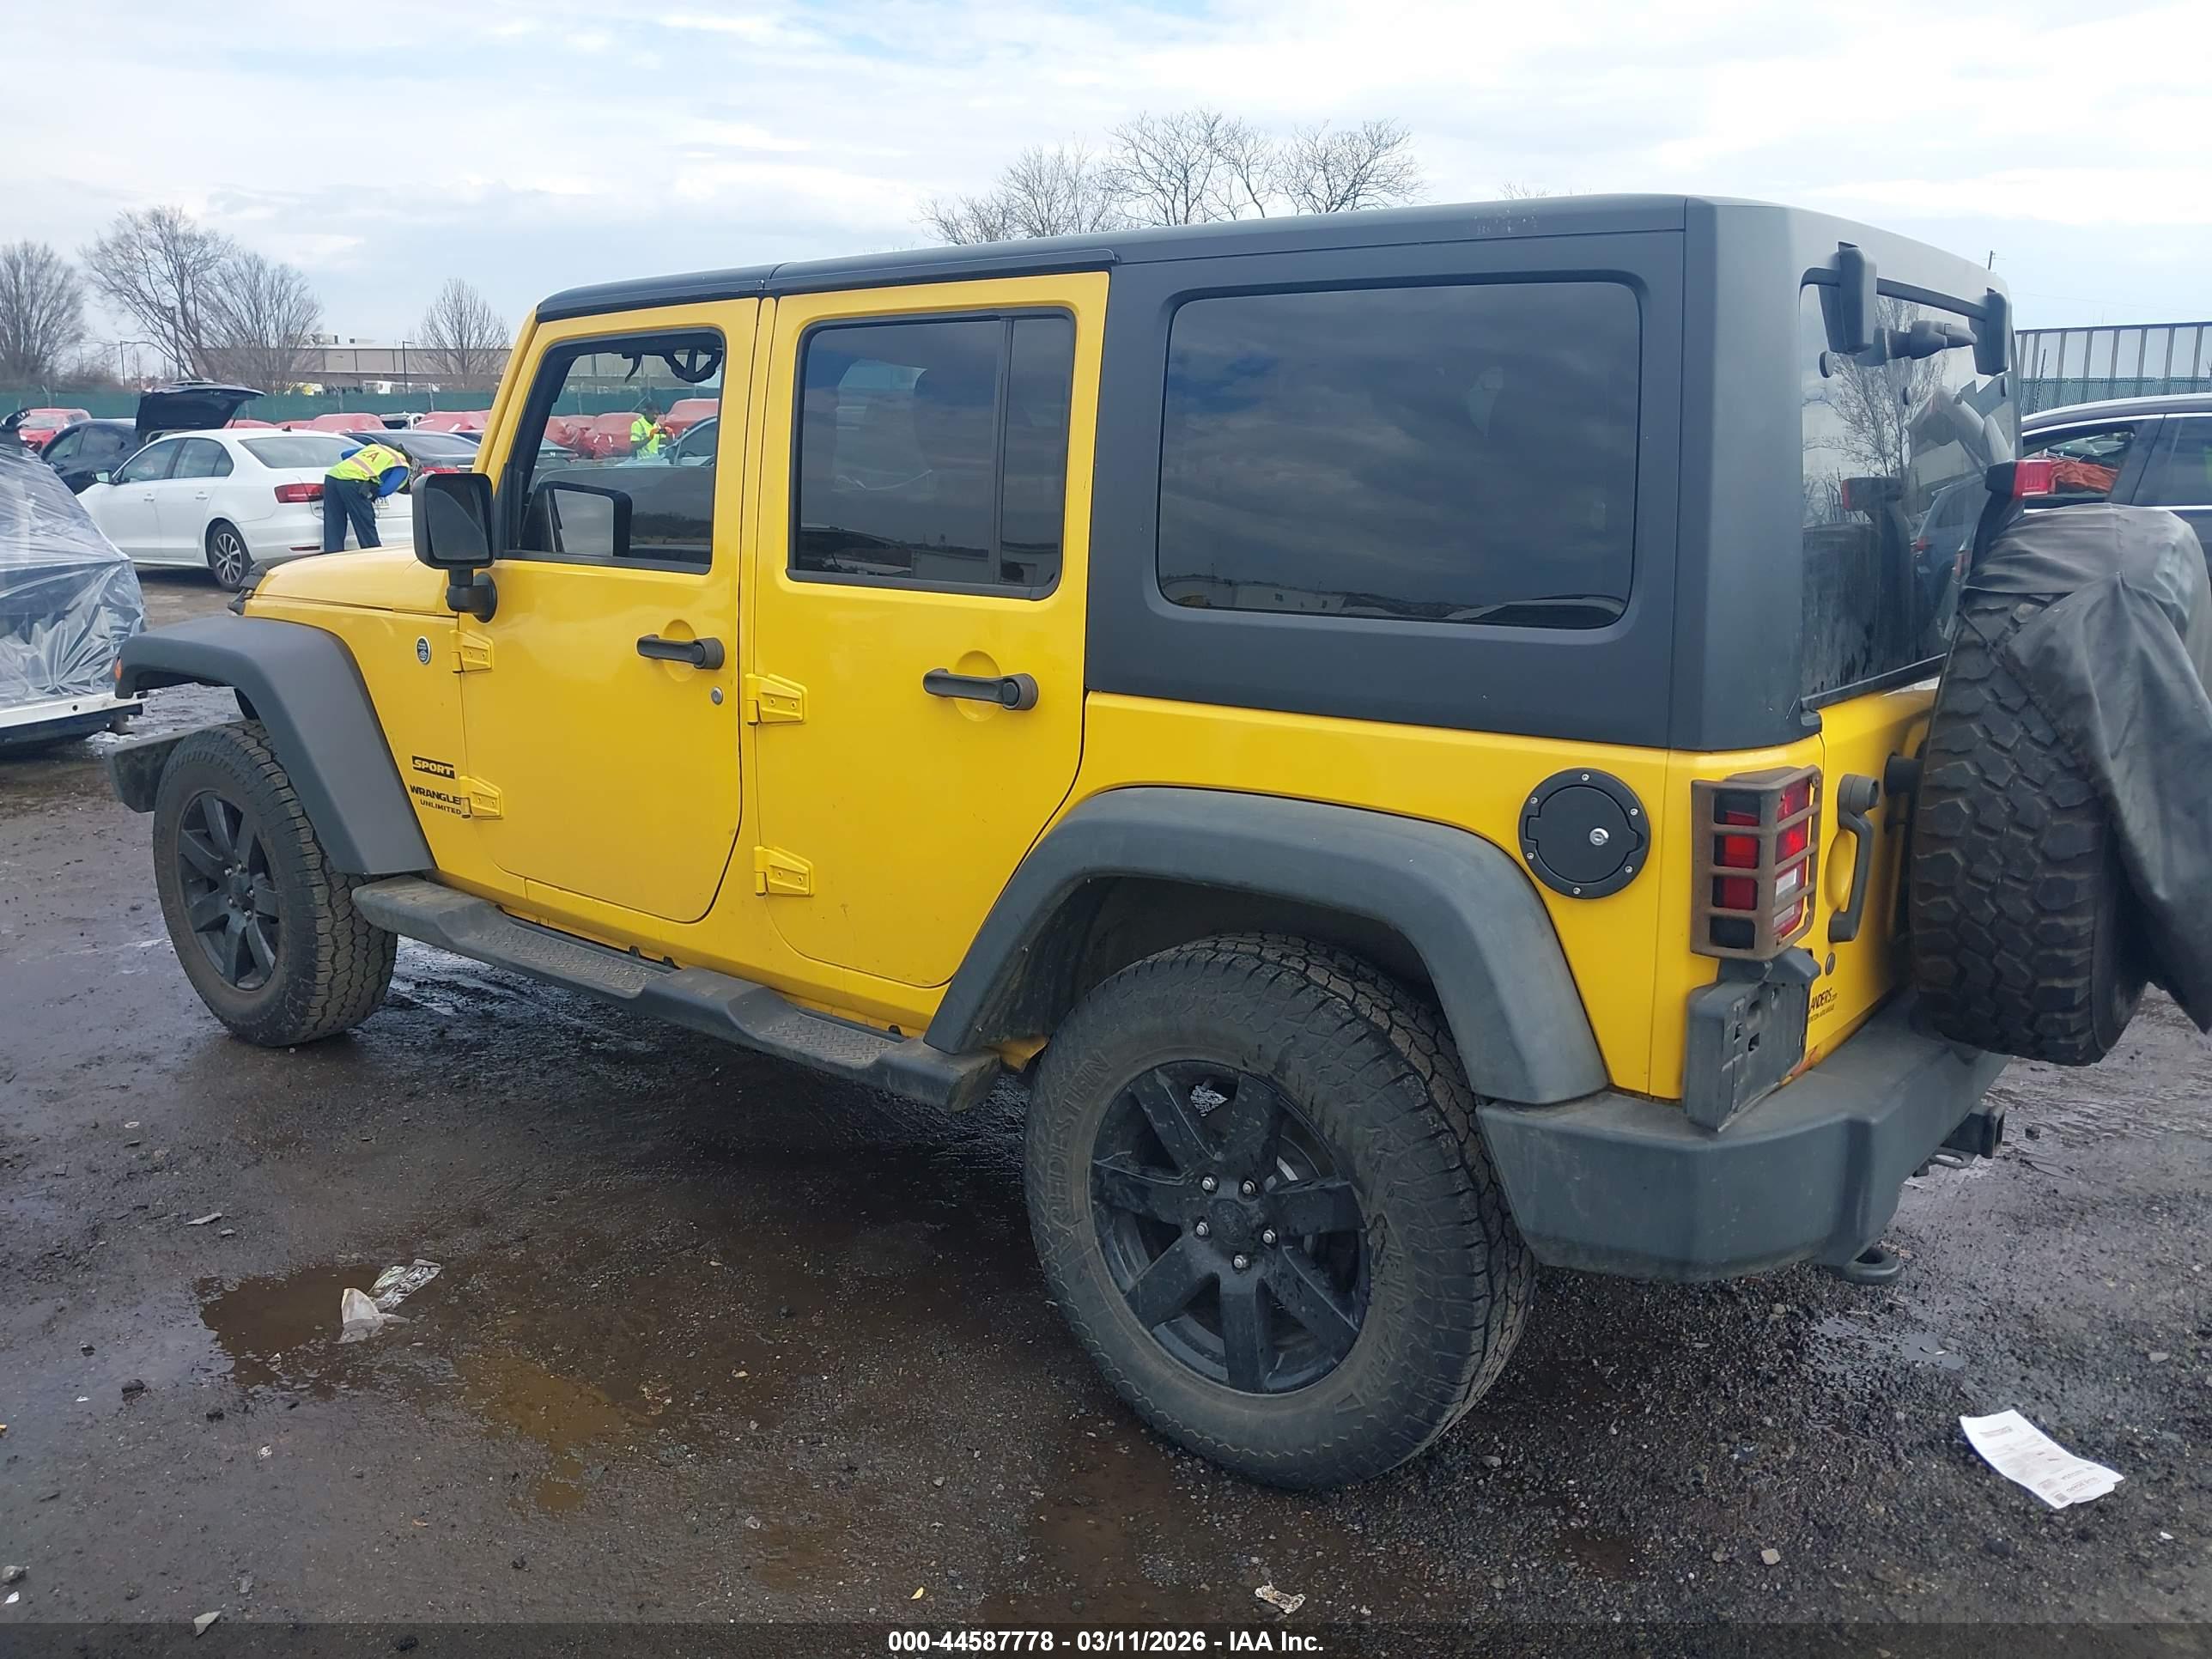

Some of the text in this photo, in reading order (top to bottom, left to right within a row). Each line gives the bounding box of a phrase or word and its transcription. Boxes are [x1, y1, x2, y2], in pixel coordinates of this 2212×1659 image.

[413, 758, 455, 777] SPORT
[410, 784, 461, 805] WRANGLE
[420, 799, 462, 815] UNLIMITED
